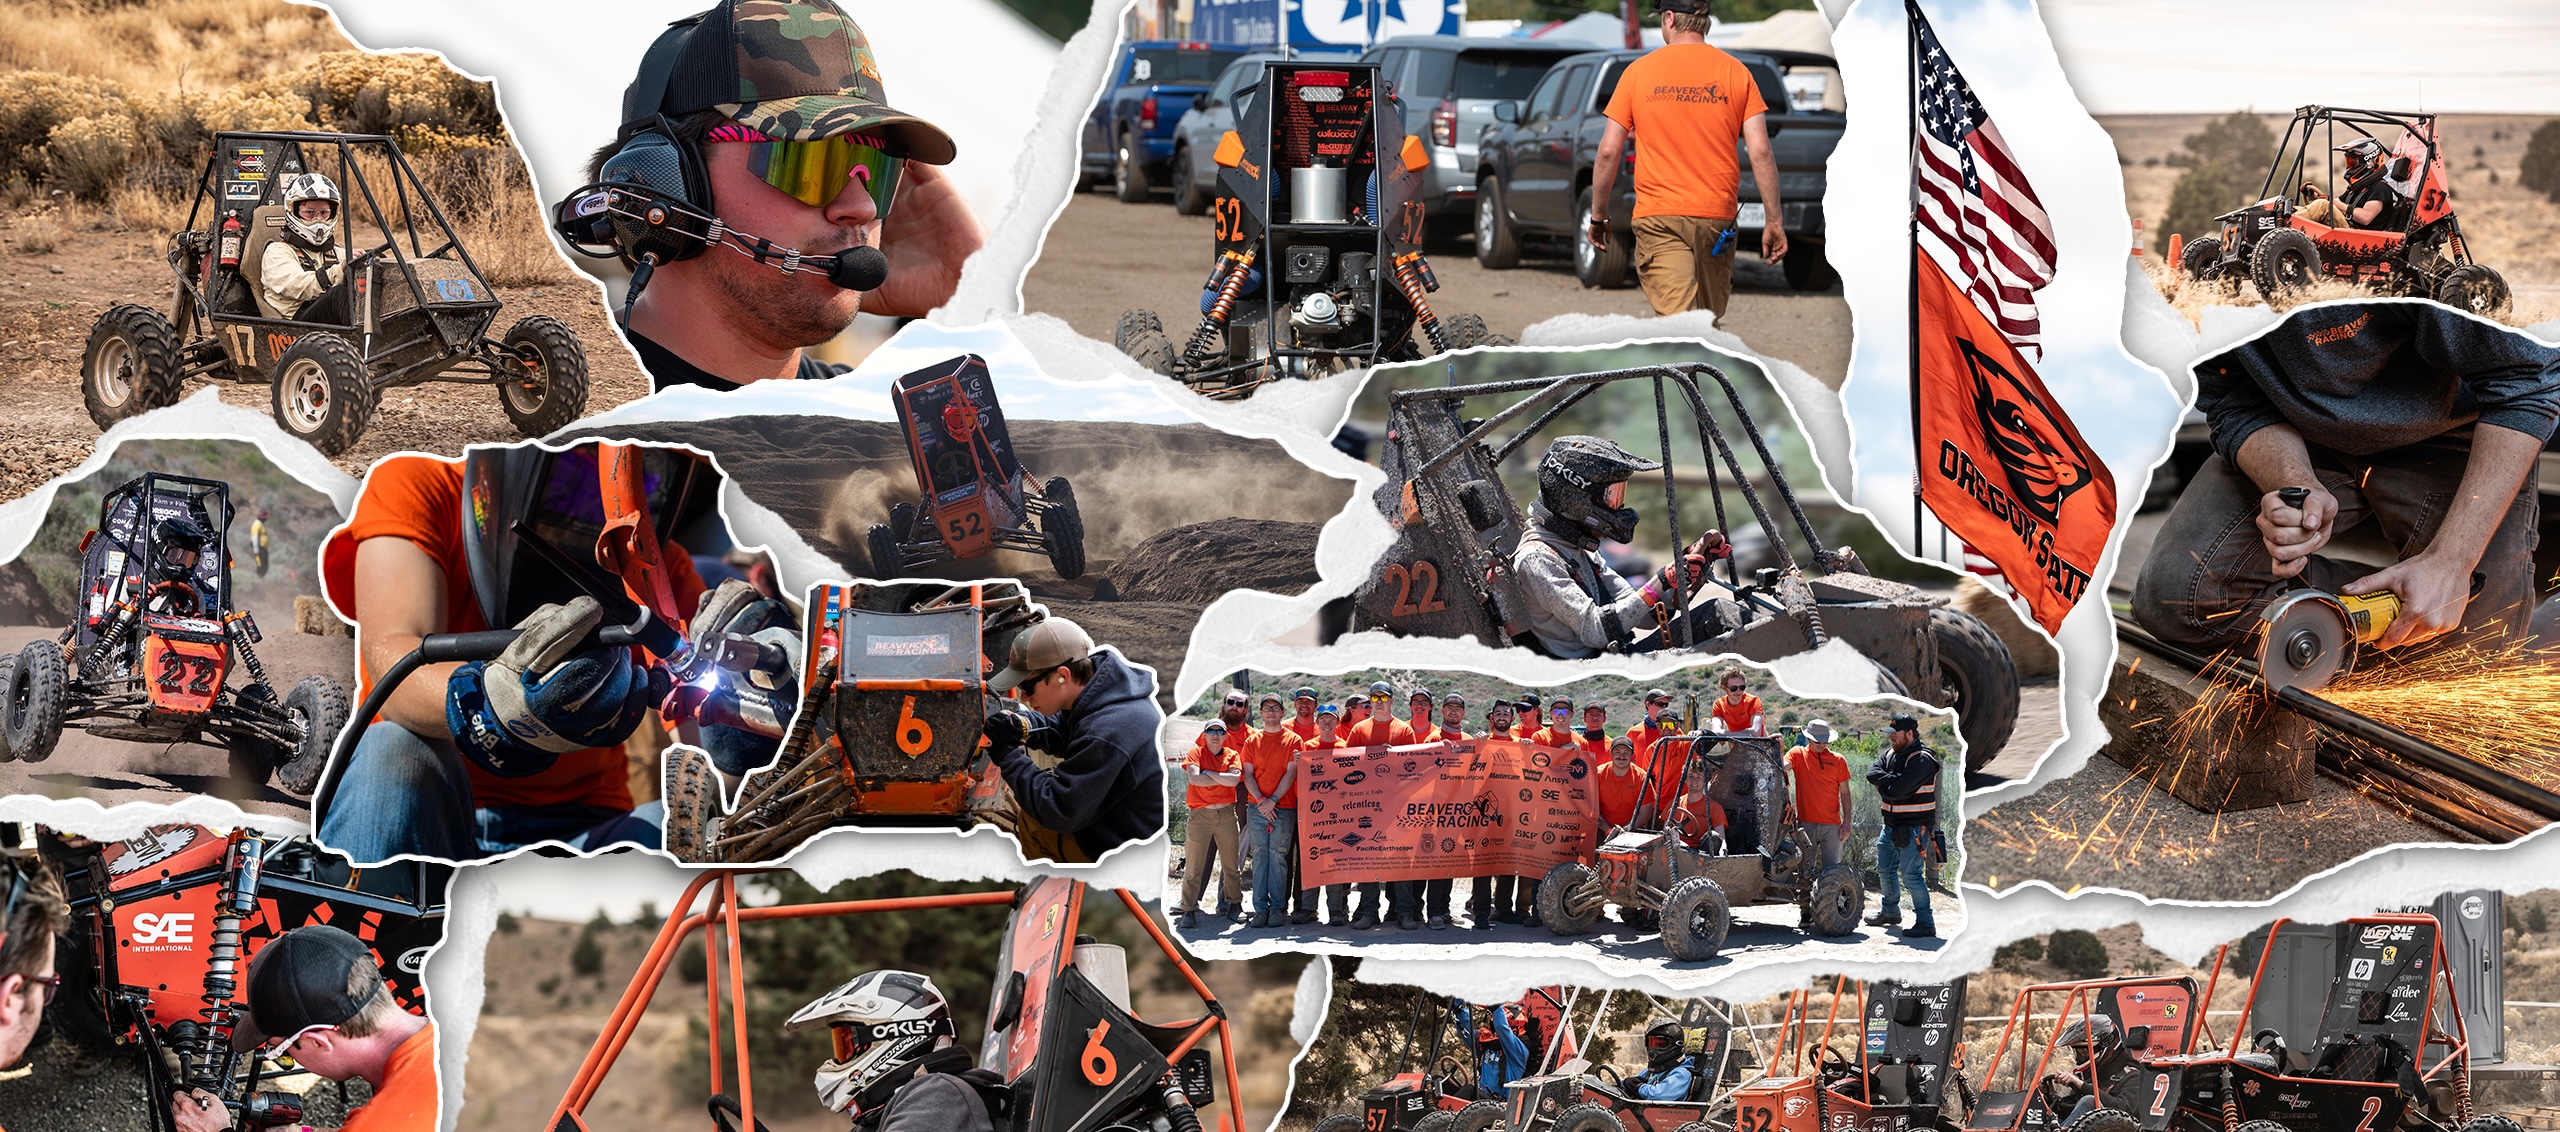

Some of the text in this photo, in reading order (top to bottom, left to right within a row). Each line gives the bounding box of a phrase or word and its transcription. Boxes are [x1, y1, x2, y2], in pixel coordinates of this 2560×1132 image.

[1654, 86, 1697, 95] BEAVER
[1675, 95, 1718, 104] RACING
[1325, 105, 1358, 114] SELWAY
[1317, 130, 1356, 138] wilwood
[228, 184, 257, 193] ATS
[2425, 189, 2447, 212] 57
[1216, 198, 1243, 241] 52
[1403, 201, 1425, 244] 52
[2258, 217, 2275, 226] SAE
[2222, 226, 2239, 252] 57
[2330, 312, 2369, 335] BEAVER
[225, 325, 257, 367] 17
[2315, 330, 2355, 346] RACING
[1548, 457, 1592, 490] OAKLEY
[940, 484, 976, 500] OREGON
[947, 491, 970, 501] TOOL
[1939, 439, 2038, 554] OREGON
[950, 512, 984, 541] 52
[1384, 560, 1447, 617] 22
[875, 642, 916, 650] BEAVER
[896, 648, 937, 656] RACING
[156, 651, 212, 692] 22
[895, 694, 933, 756] 6
[1333, 755, 1360, 764] OREGON
[1489, 772, 1521, 780] Mastercam
[1544, 775, 1569, 785] Ansys
[1541, 788, 1561, 801] SAE
[1342, 800, 1381, 811] relentless
[1407, 803, 1464, 816] BEAVER
[1556, 808, 1581, 817] SELWAY
[1313, 817, 1355, 827] HYSTER-YALE
[1436, 815, 1489, 828] RACING
[1515, 829, 1538, 840] SKF
[1601, 861, 1627, 888] 22
[132, 912, 194, 944] SAE
[2390, 925, 2416, 941] SAE
[132, 945, 193, 953] INTERNATIONAL
[2384, 1002, 2409, 1023] Linn
[872, 1020, 937, 1039] OAKLEY
[1081, 1018, 1117, 1086] 6
[2150, 1073, 2171, 1117] 2
[1408, 1099, 1423, 1108] SAE
[1513, 1090, 1525, 1126] 1
[1367, 1108, 1388, 1132] 57
[1742, 1106, 1772, 1132] 52
[1833, 1115, 1855, 1127] SAE
[2026, 1108, 2042, 1120] SAE
[2356, 1096, 2382, 1132] 2
